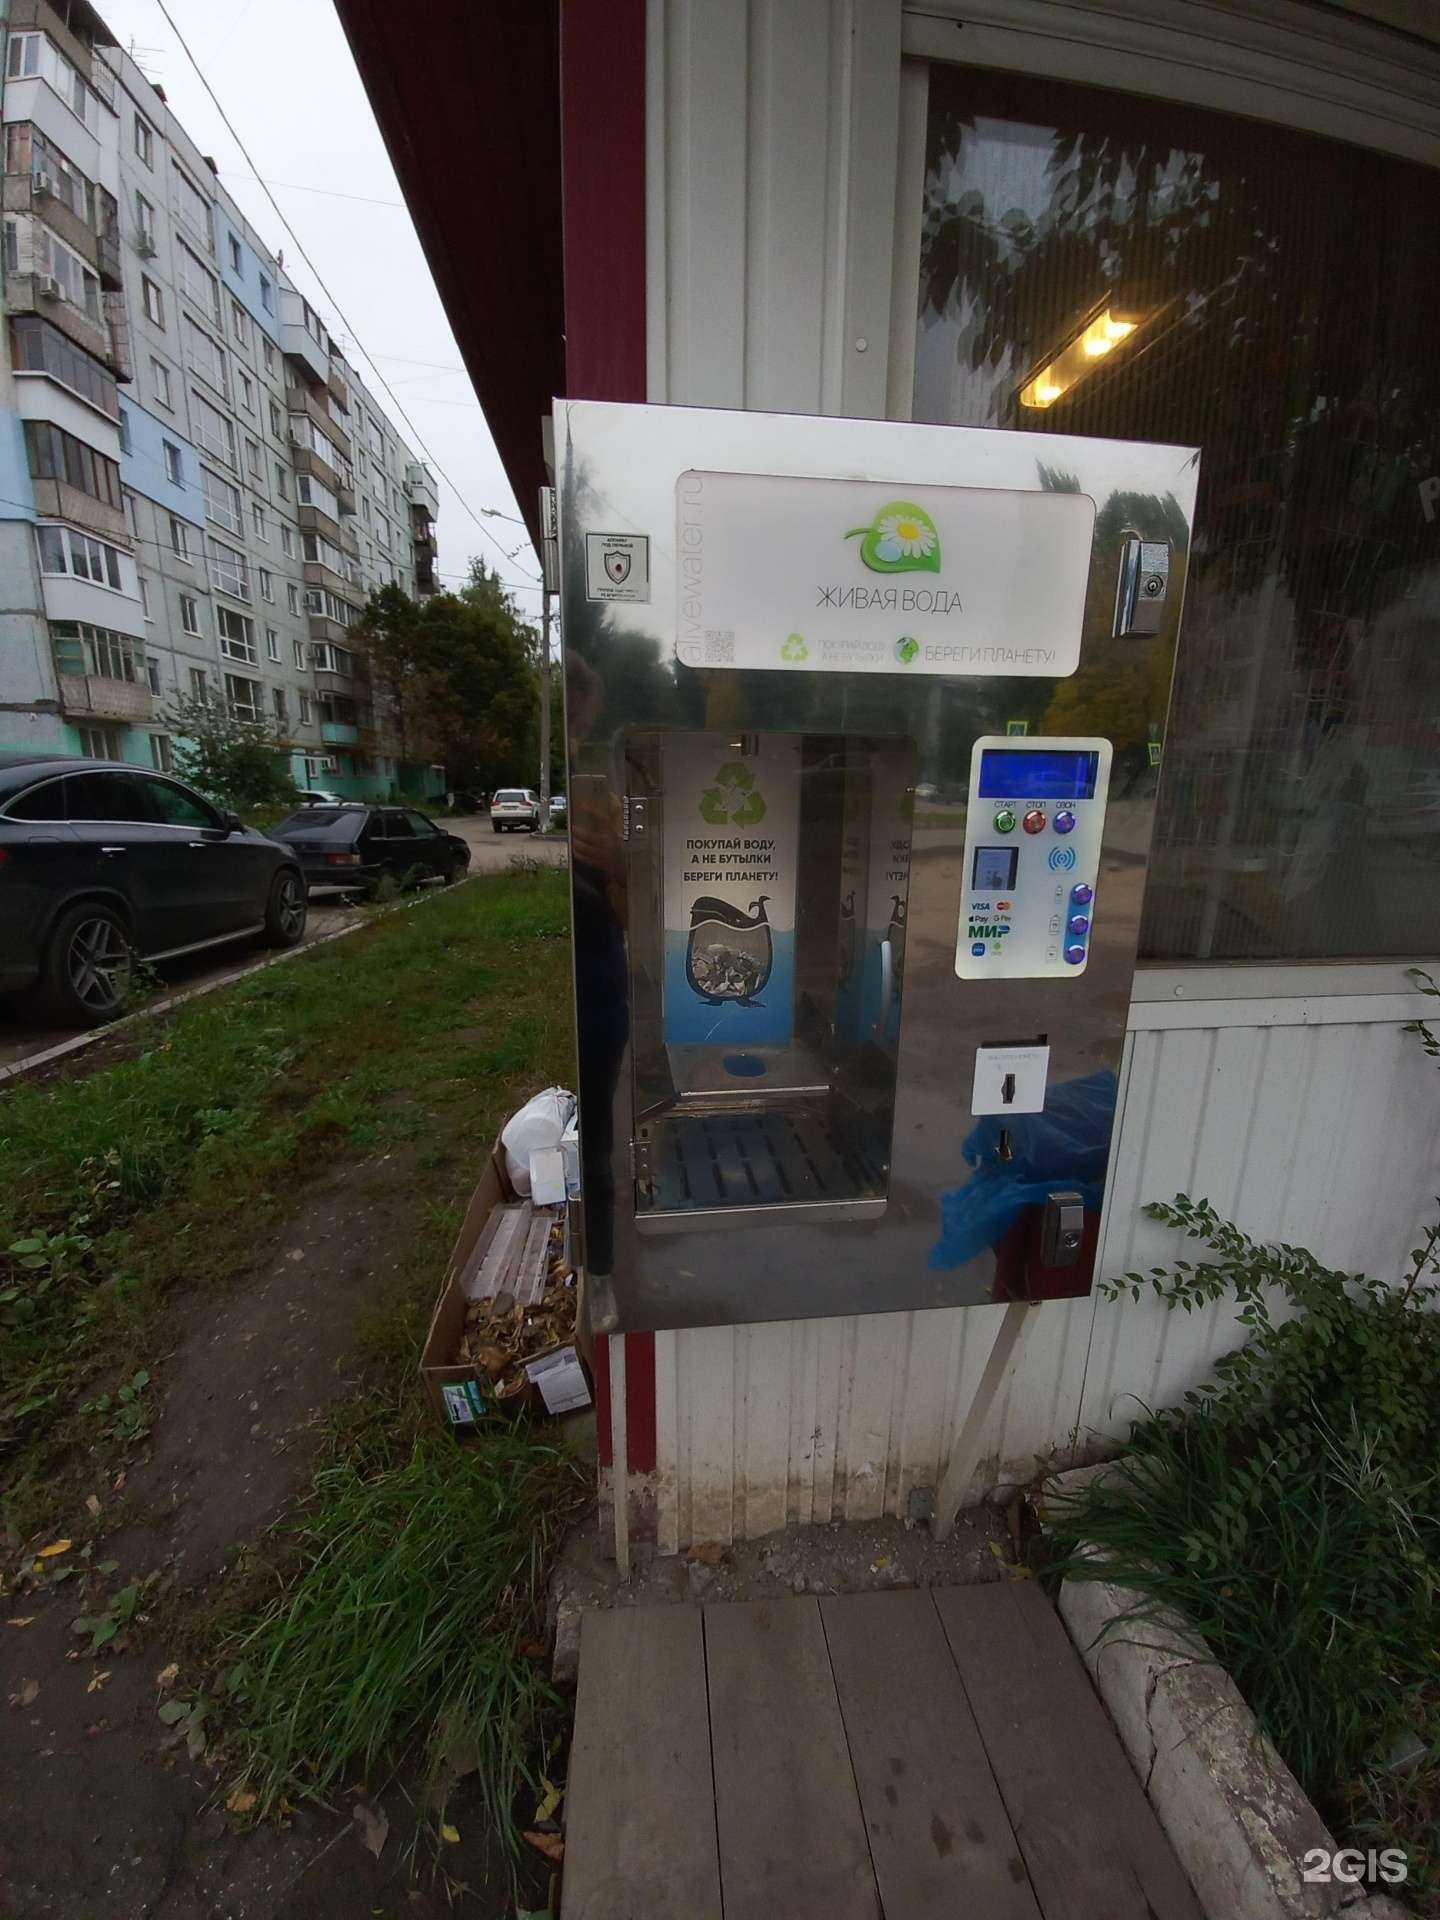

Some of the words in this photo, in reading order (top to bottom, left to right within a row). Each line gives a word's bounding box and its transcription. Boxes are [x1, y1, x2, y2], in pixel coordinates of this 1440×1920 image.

[816, 586, 897, 610] ЖИВАЯ
[902, 589, 963, 615] ВОДА
[925, 645, 981, 662] БЕРЕГИ
[983, 647, 1056, 664] ПЛАНЕТУ!
[1026, 801, 1046, 809] СТОП
[686, 837, 741, 849] ПОКУПАЙ
[744, 839, 776, 851] ВОДУ,
[691, 854, 699, 864] А
[702, 854, 716, 864] НЕ
[719, 854, 771, 864] БУТЫЛКИ
[683, 872, 722, 881] БЕРЕГИ
[726, 872, 778, 881] ПЛАНЕТУ!
[971, 902, 990, 911] VISA
[975, 915, 989, 924] Pay
[968, 925, 1010, 938] МИР
